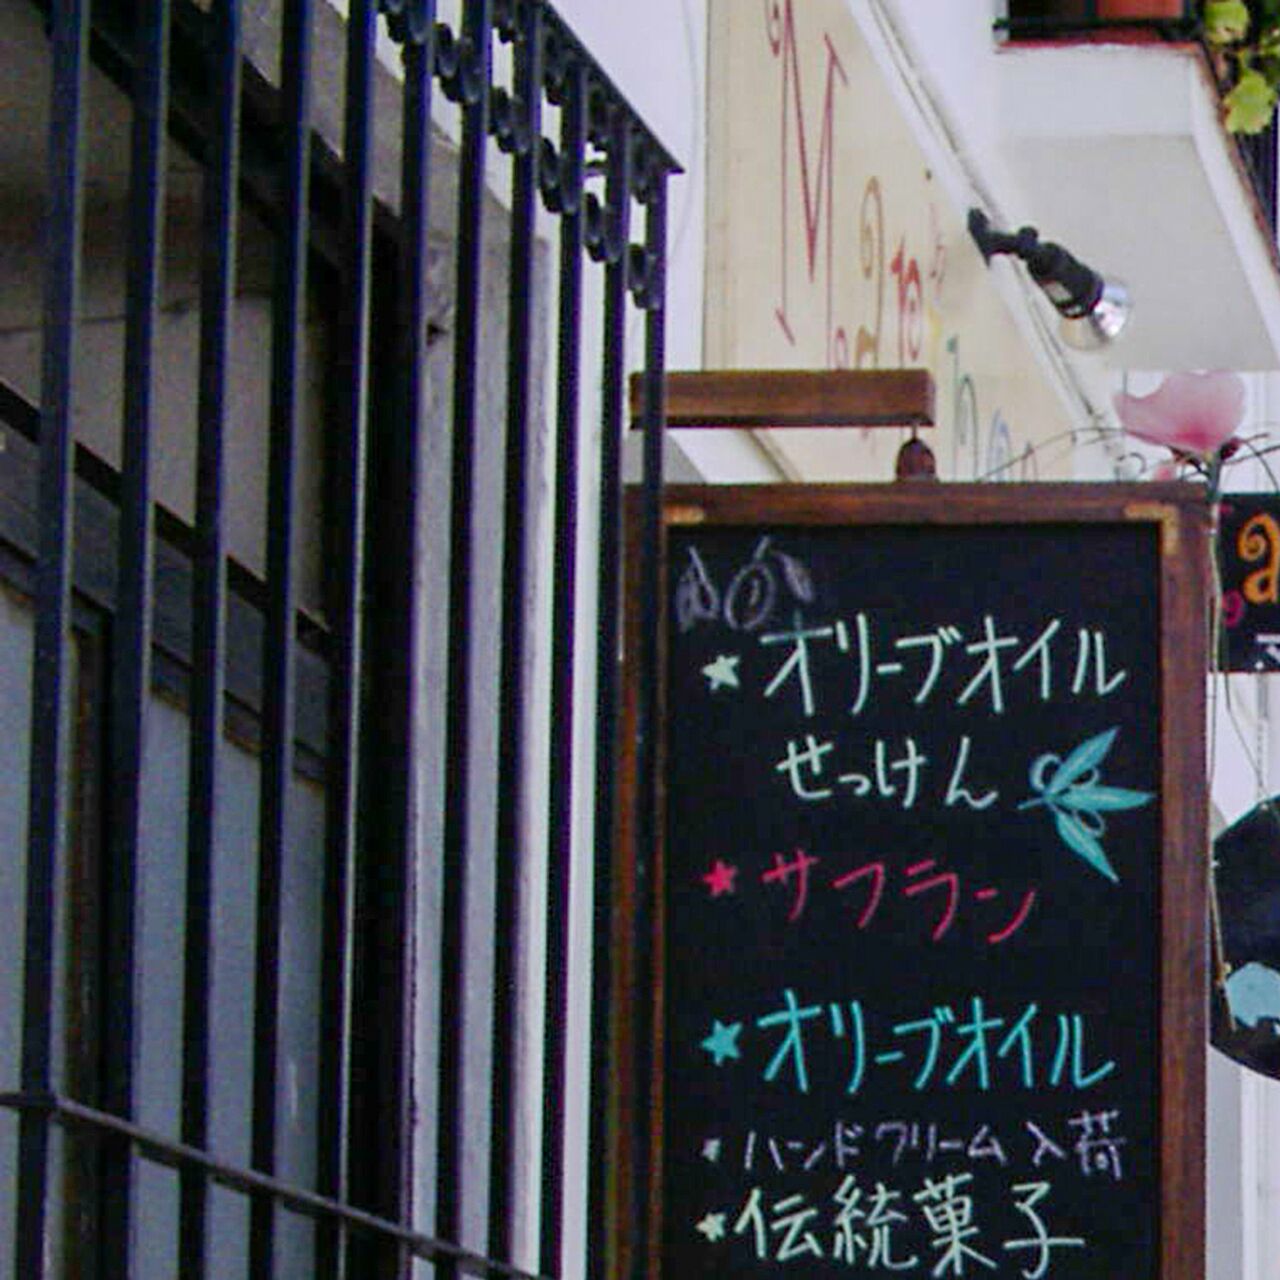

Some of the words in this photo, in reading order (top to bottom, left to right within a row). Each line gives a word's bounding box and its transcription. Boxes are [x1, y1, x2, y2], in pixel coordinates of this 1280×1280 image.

[760, 610, 1126, 717] オリーブオイル
[776, 735, 998, 808] せっけん
[762, 850, 1036, 943] サフラン
[757, 989, 1115, 1095] オリーブオイル
[734, 1172, 1085, 1280] 伝統菓子
